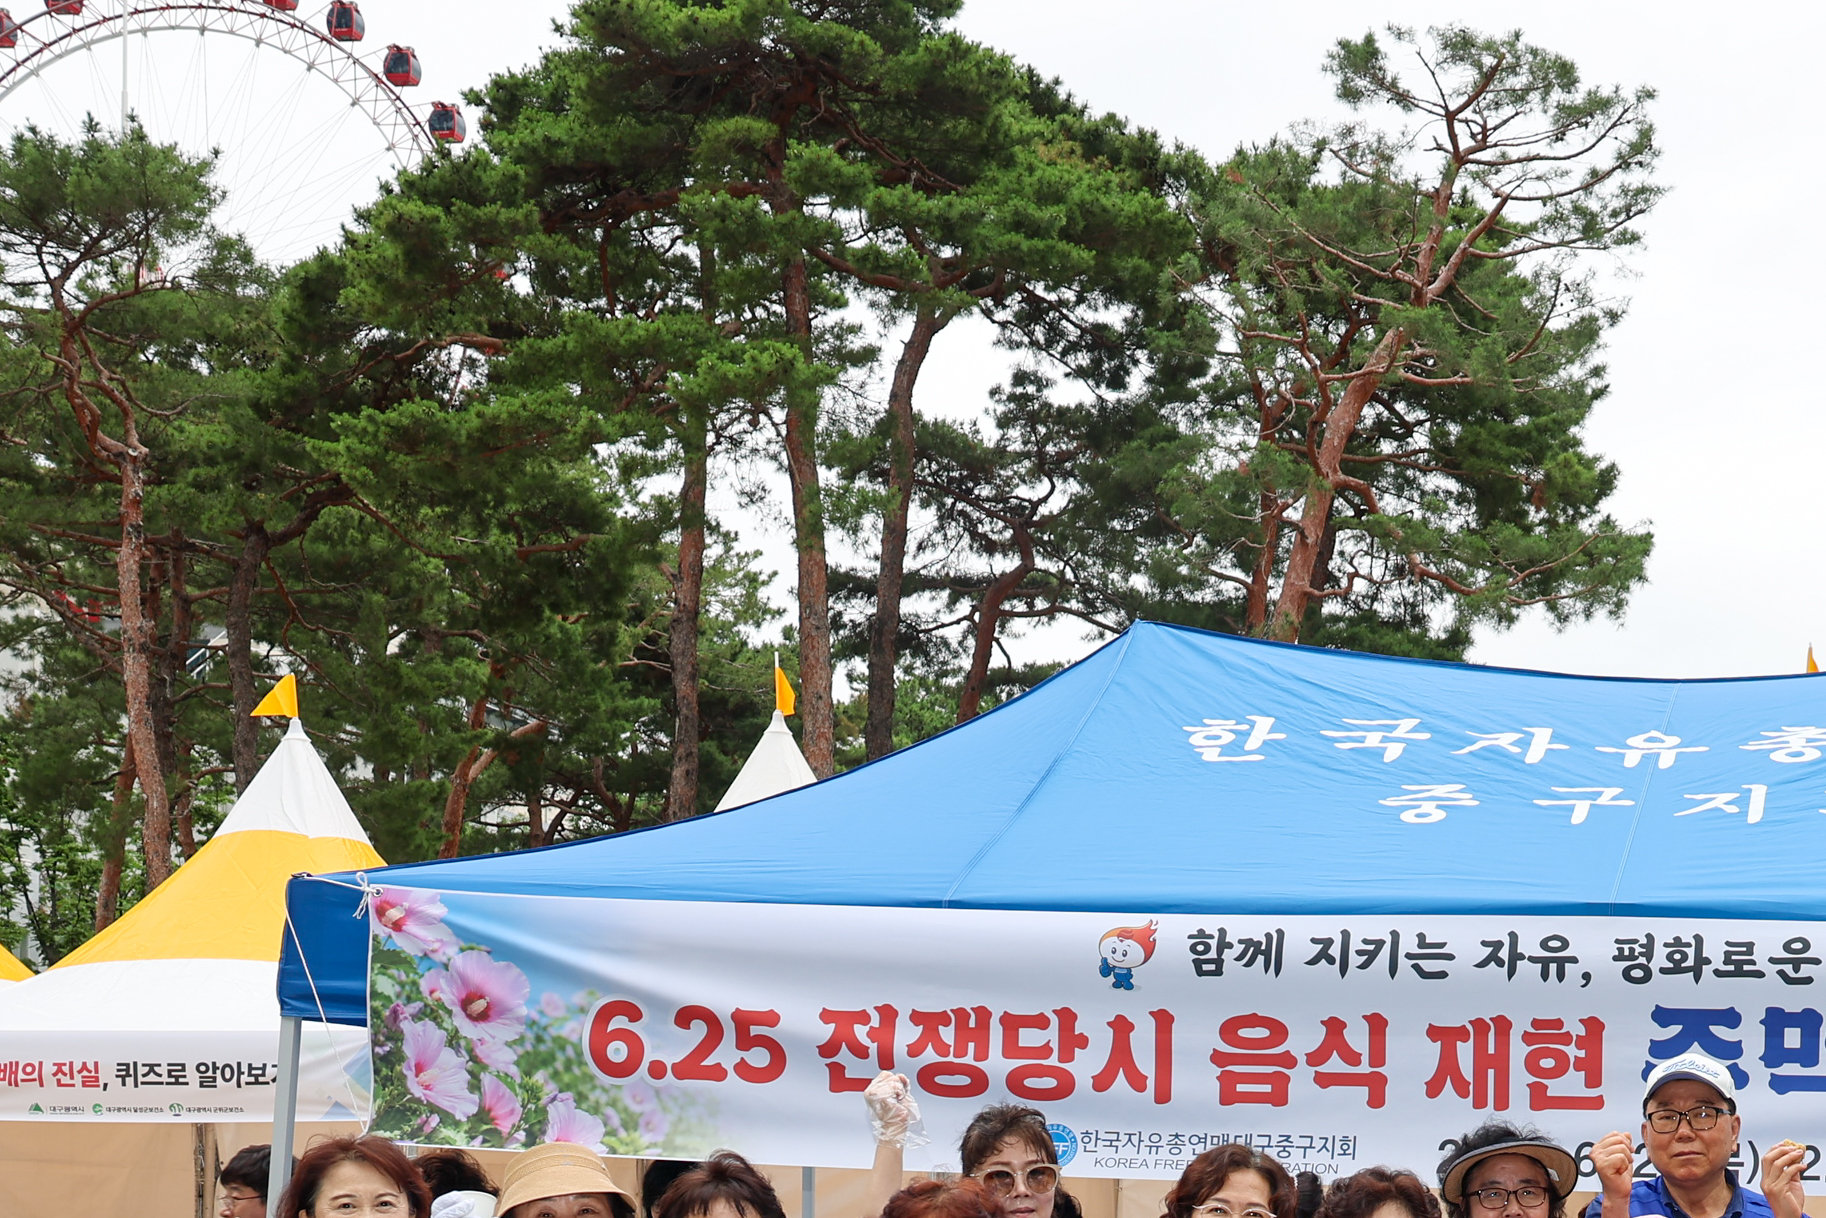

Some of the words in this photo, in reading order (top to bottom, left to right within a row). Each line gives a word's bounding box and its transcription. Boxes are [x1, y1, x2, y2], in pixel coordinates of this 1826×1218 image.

[1188, 928, 1284, 980] 함께
[1305, 929, 1455, 981] 지키는
[1474, 931, 1591, 988] 자유,
[1612, 935, 1822, 986] 평화로운
[52, 1061, 109, 1091] 진실,
[115, 1061, 190, 1089] 퀴즈로
[588, 1000, 787, 1083] 6.25
[817, 1003, 1174, 1104] 전쟁당시
[1211, 1013, 1389, 1108] 음식
[1425, 1014, 1605, 1111] 재현
[1093, 1156, 1149, 1170] KOREA
[1153, 1158, 1192, 1171] FREE
